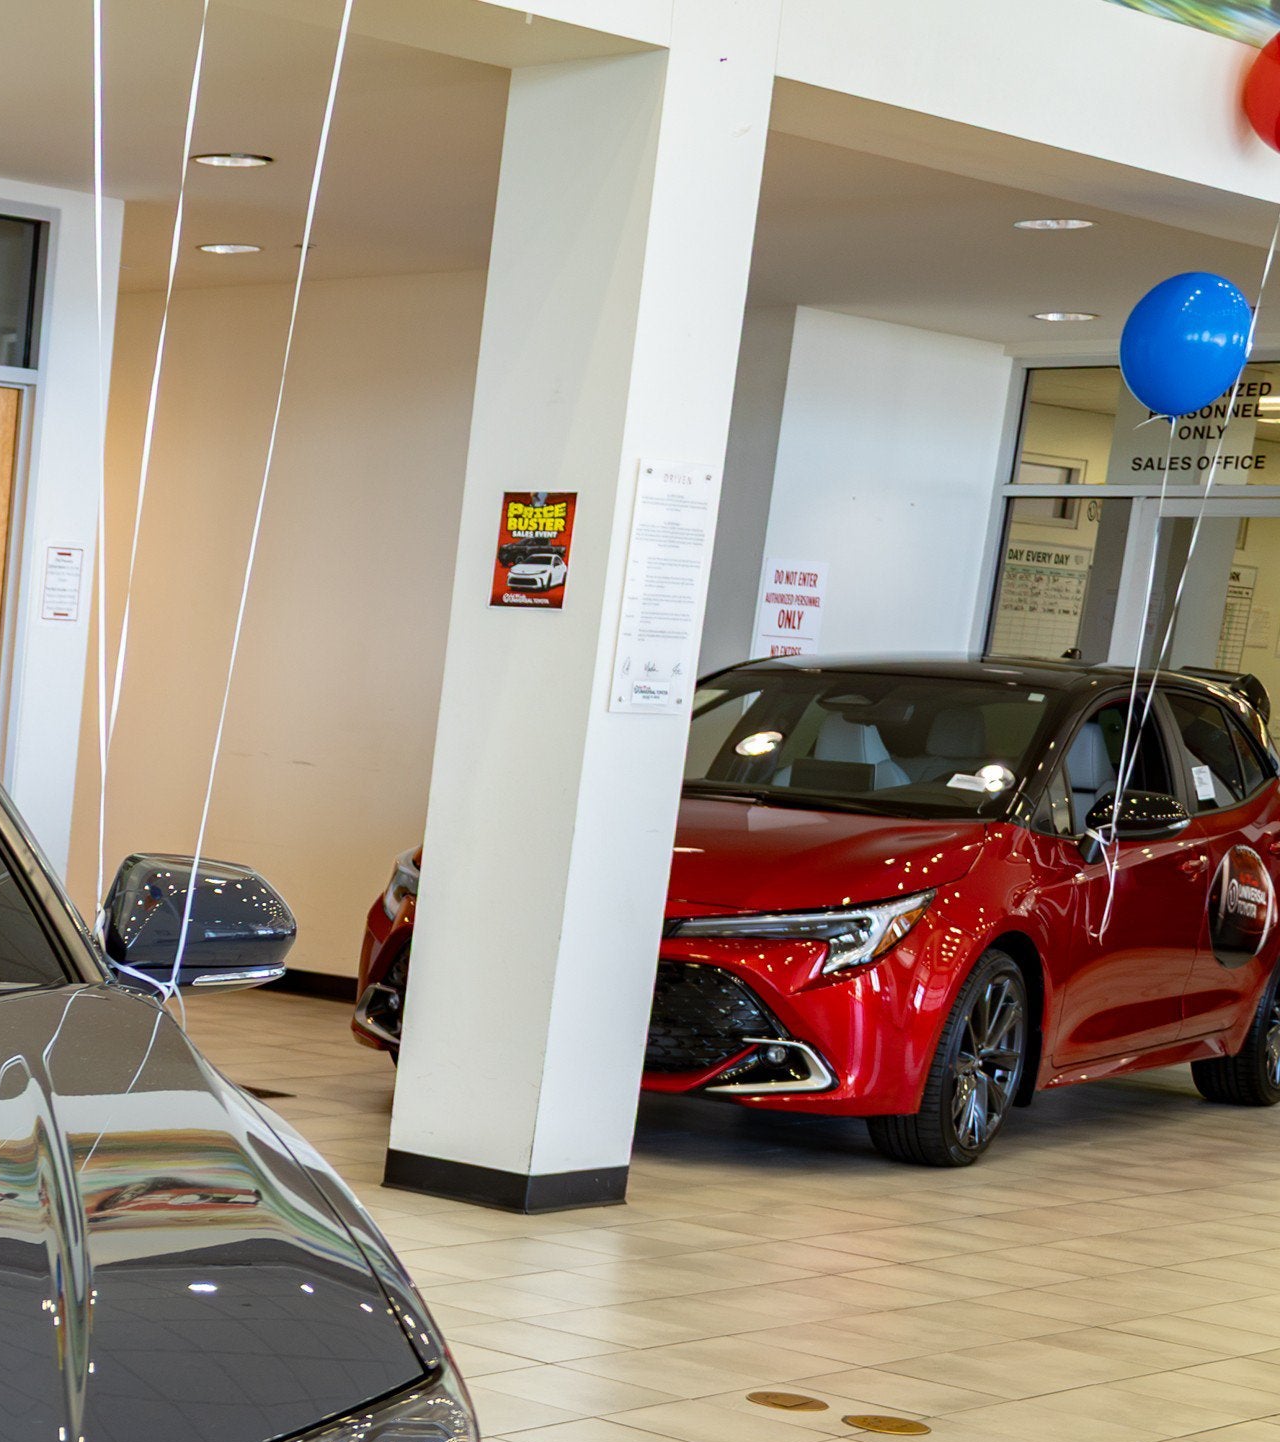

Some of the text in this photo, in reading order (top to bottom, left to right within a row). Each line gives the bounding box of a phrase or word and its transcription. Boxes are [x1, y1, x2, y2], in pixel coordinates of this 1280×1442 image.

[1149, 404, 1264, 419] SONNEL
[1178, 425, 1227, 440] ONLY
[1131, 455, 1266, 471] SALES OFFICE
[507, 502, 567, 518] PRICE
[507, 517, 565, 531] BUSTER
[512, 530, 558, 538] SALES EVENT
[1008, 549, 1071, 566] DAY EVERY DAY
[774, 569, 819, 588] DO NOT ENTER
[777, 609, 805, 630] ONLY
